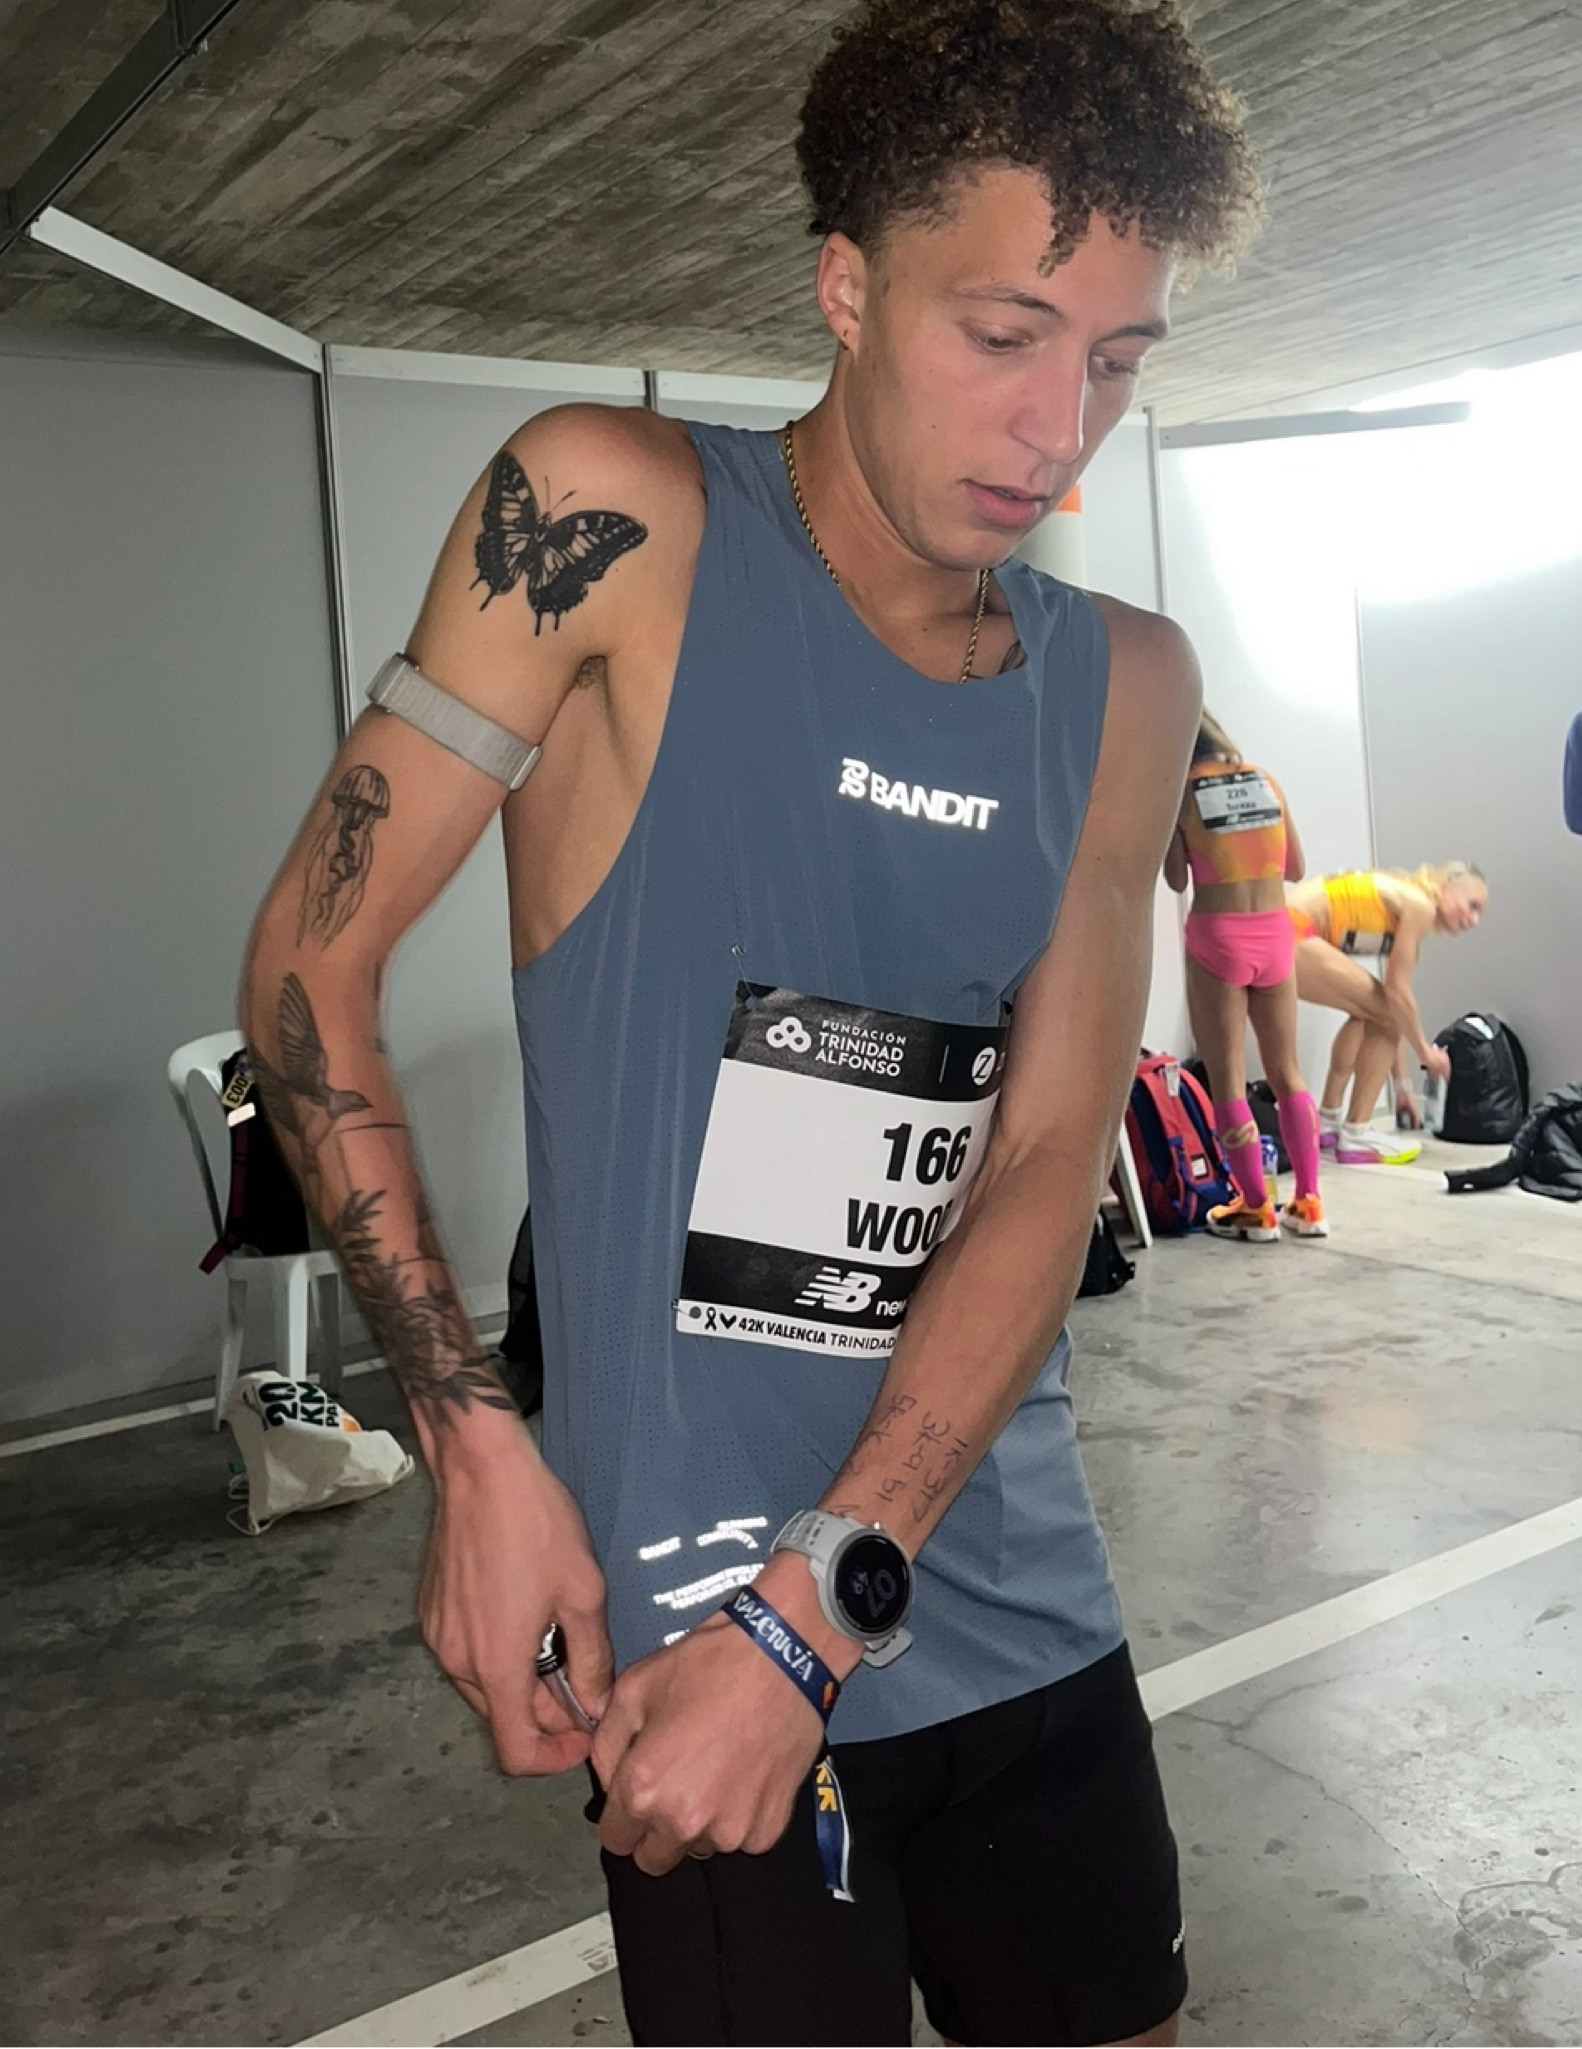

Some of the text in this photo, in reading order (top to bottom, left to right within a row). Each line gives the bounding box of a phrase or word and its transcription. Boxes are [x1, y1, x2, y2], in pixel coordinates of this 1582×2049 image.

[870, 772, 999, 830] BANDIT
[819, 1032, 904, 1062] TRINIDAD
[822, 1020, 907, 1045] FUNDACIÓN
[815, 1048, 900, 1077] ALFONSO
[884, 1123, 972, 1186] 166
[738, 1317, 765, 1332] 42K
[767, 1322, 827, 1345] VALENCIA
[259, 1382, 298, 1427] 20
